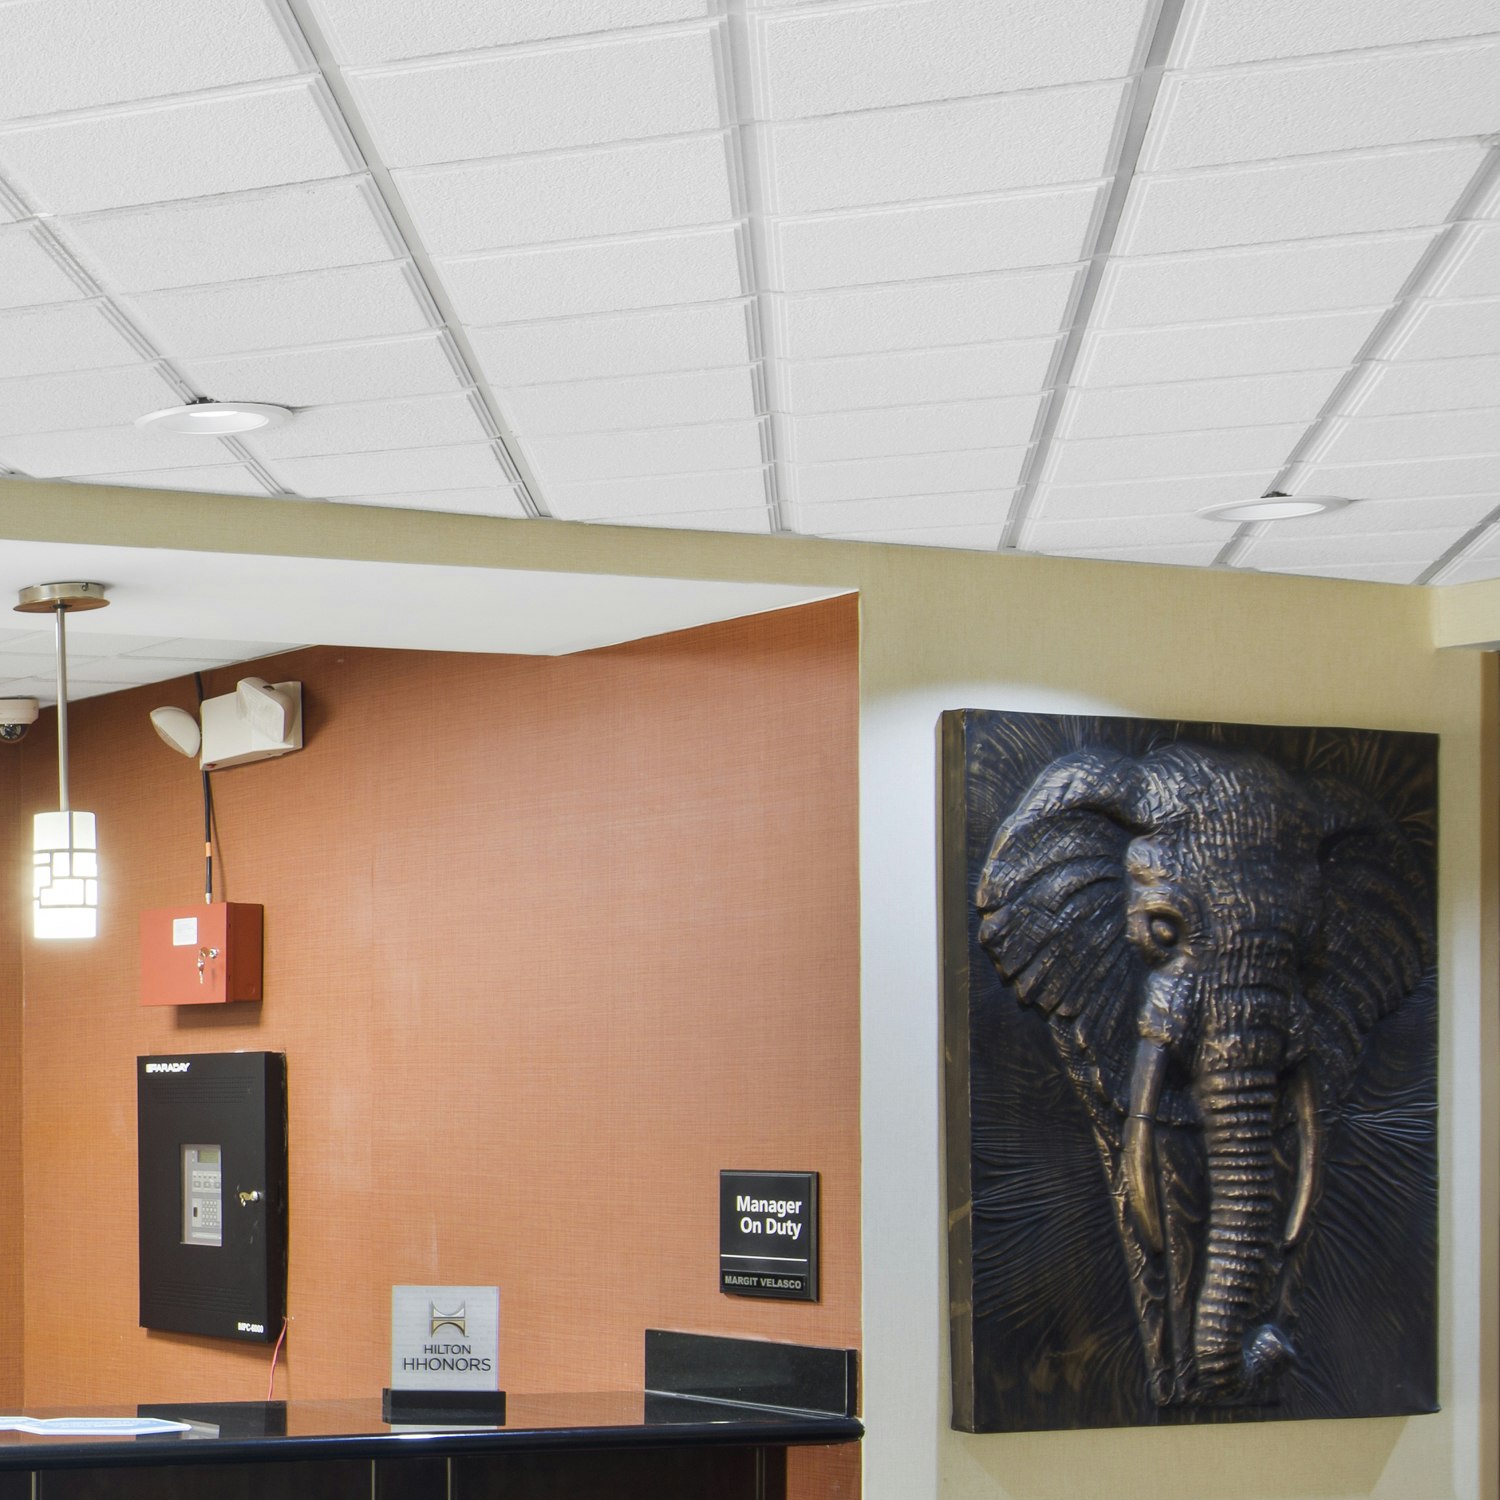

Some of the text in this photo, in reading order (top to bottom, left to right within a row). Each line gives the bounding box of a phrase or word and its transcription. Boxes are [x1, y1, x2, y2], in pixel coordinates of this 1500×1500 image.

[147, 1062, 190, 1073] FARADAY
[736, 1195, 802, 1218] Manager
[740, 1217, 802, 1240] On Duty
[724, 1275, 802, 1290] MARGIT VELASCO
[424, 1344, 472, 1355] HILTON
[403, 1358, 492, 1372] HHONORS
